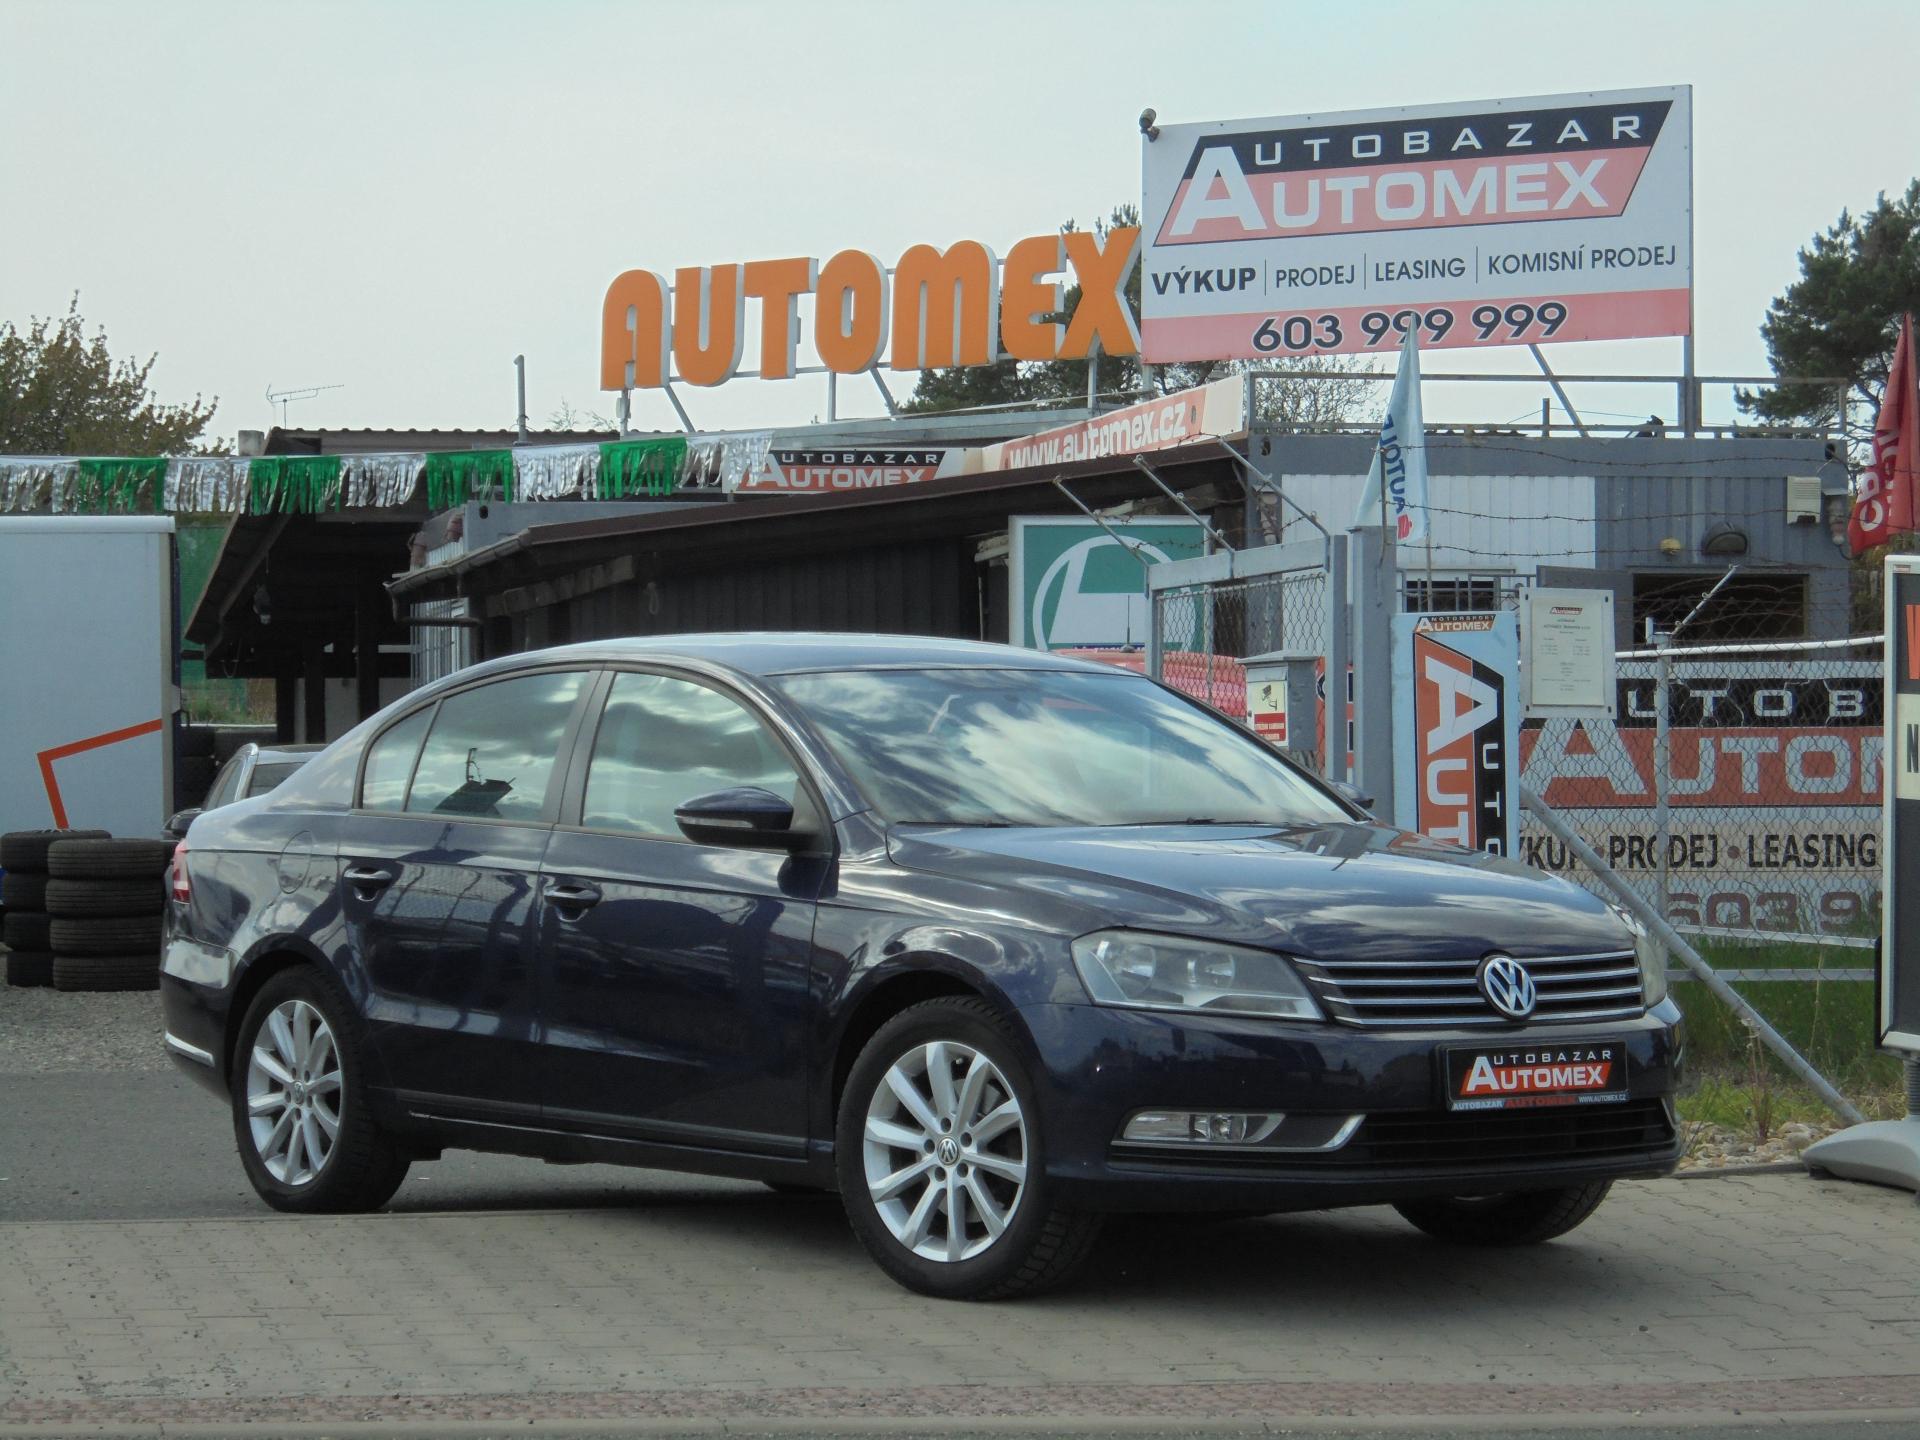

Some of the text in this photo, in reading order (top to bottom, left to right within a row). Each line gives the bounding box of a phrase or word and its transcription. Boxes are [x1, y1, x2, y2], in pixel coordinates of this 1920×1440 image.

[1168, 145, 1609, 237] AUTOMEX
[1151, 244, 1677, 296] VÝKUP PRODEJ LEASING KOMISNÍ PRODEJ
[601, 226, 1142, 391] AUTOMEX
[1252, 301, 1568, 353] 603 999 999
[1010, 402, 1187, 468] www.automex.cz
[747, 453, 925, 488] AUTOMEX
[1416, 617, 1490, 633] AUTOMEX
[1748, 833, 1877, 869] LEASING
[1466, 1056, 1604, 1092] AUTOMEX
[1452, 1100, 1504, 1111] AUTOBAZAR
